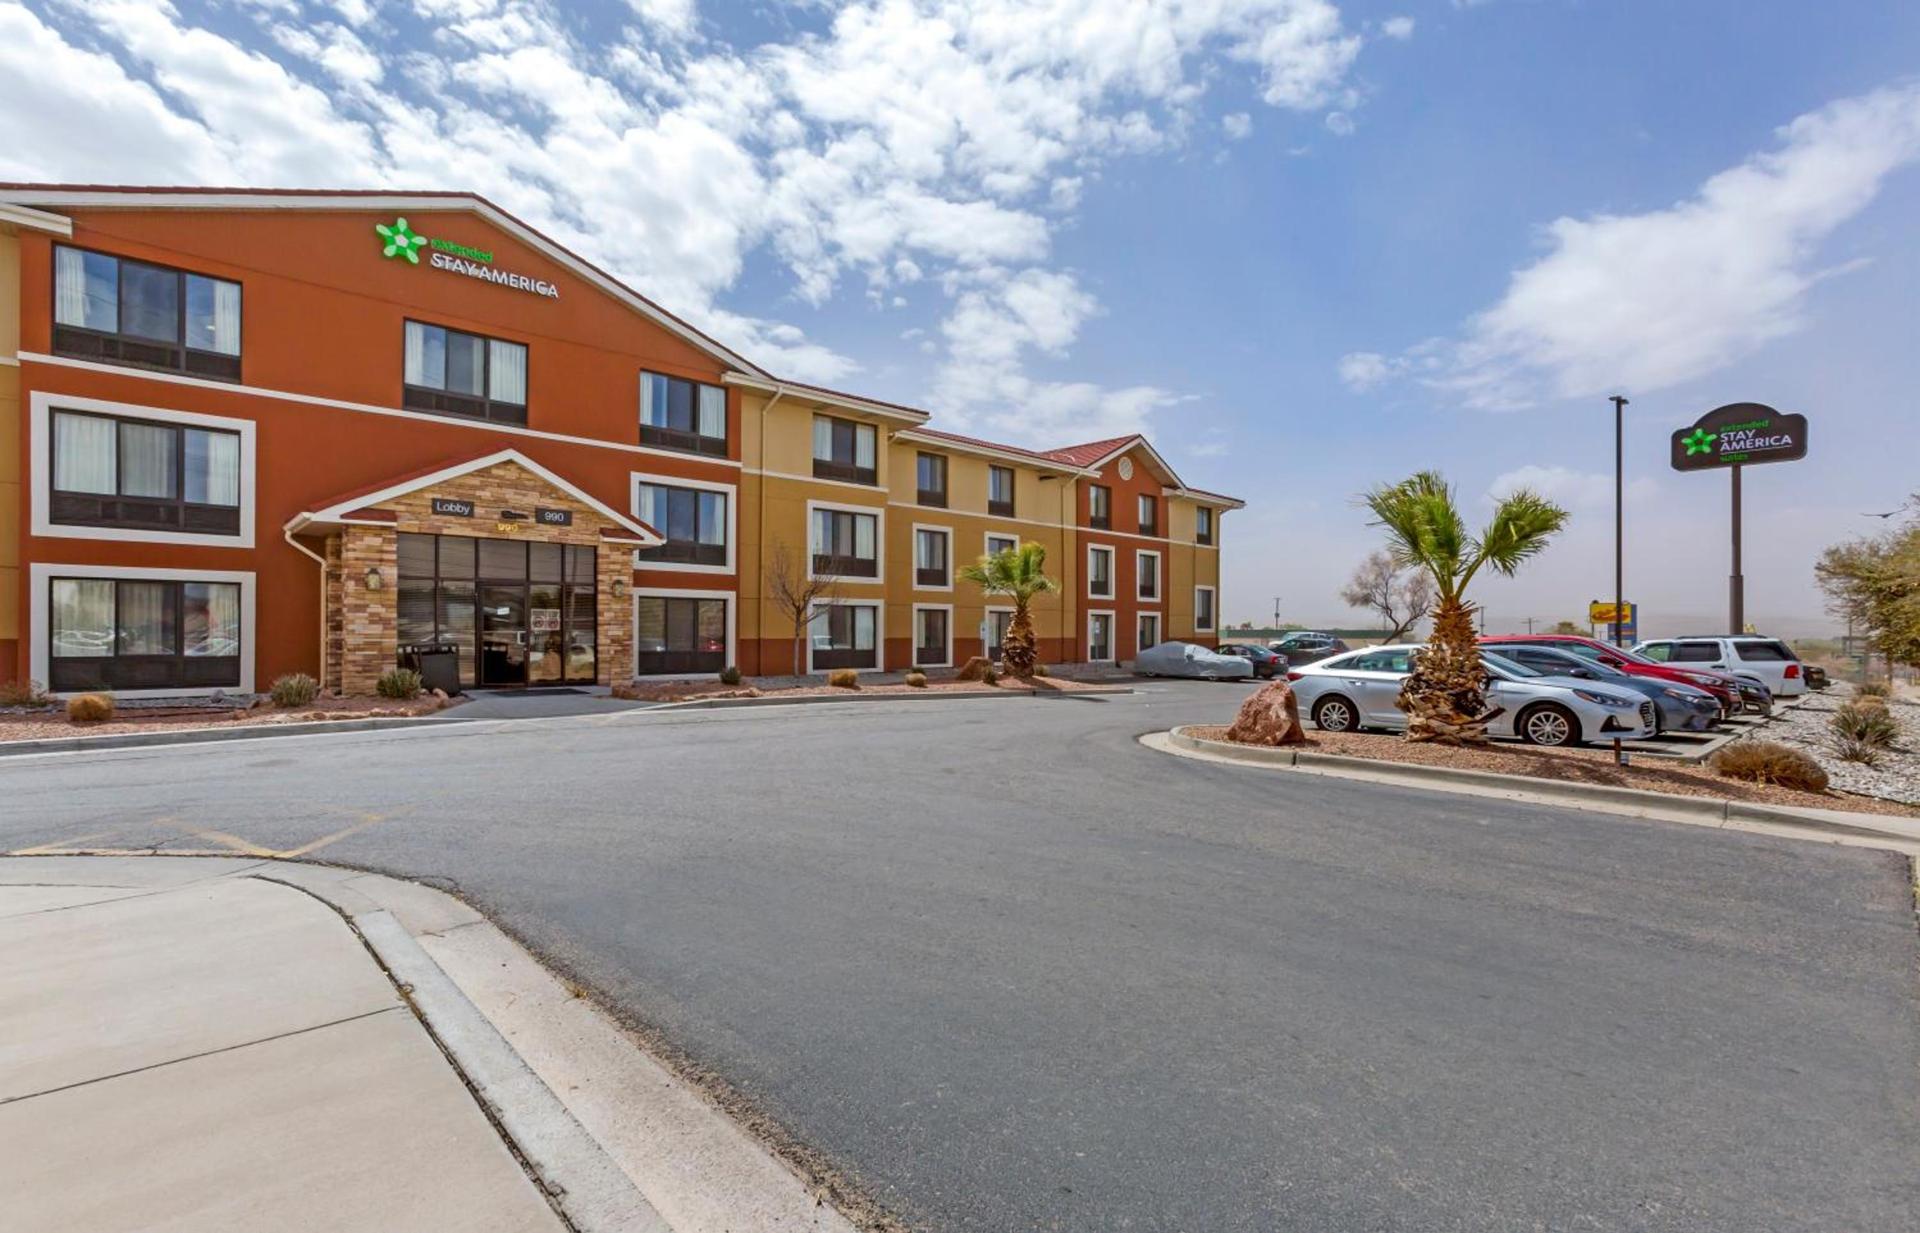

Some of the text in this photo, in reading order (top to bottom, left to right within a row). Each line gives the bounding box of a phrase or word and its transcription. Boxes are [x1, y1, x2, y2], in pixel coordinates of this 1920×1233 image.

[431, 239, 493, 263] extended
[431, 253, 559, 298] STAY AMERICA
[1720, 420, 1769, 431] extended
[1720, 429, 1756, 443] STAY
[1720, 435, 1792, 452] AMERICA
[436, 501, 471, 515] Lobby
[544, 511, 564, 522] 990
